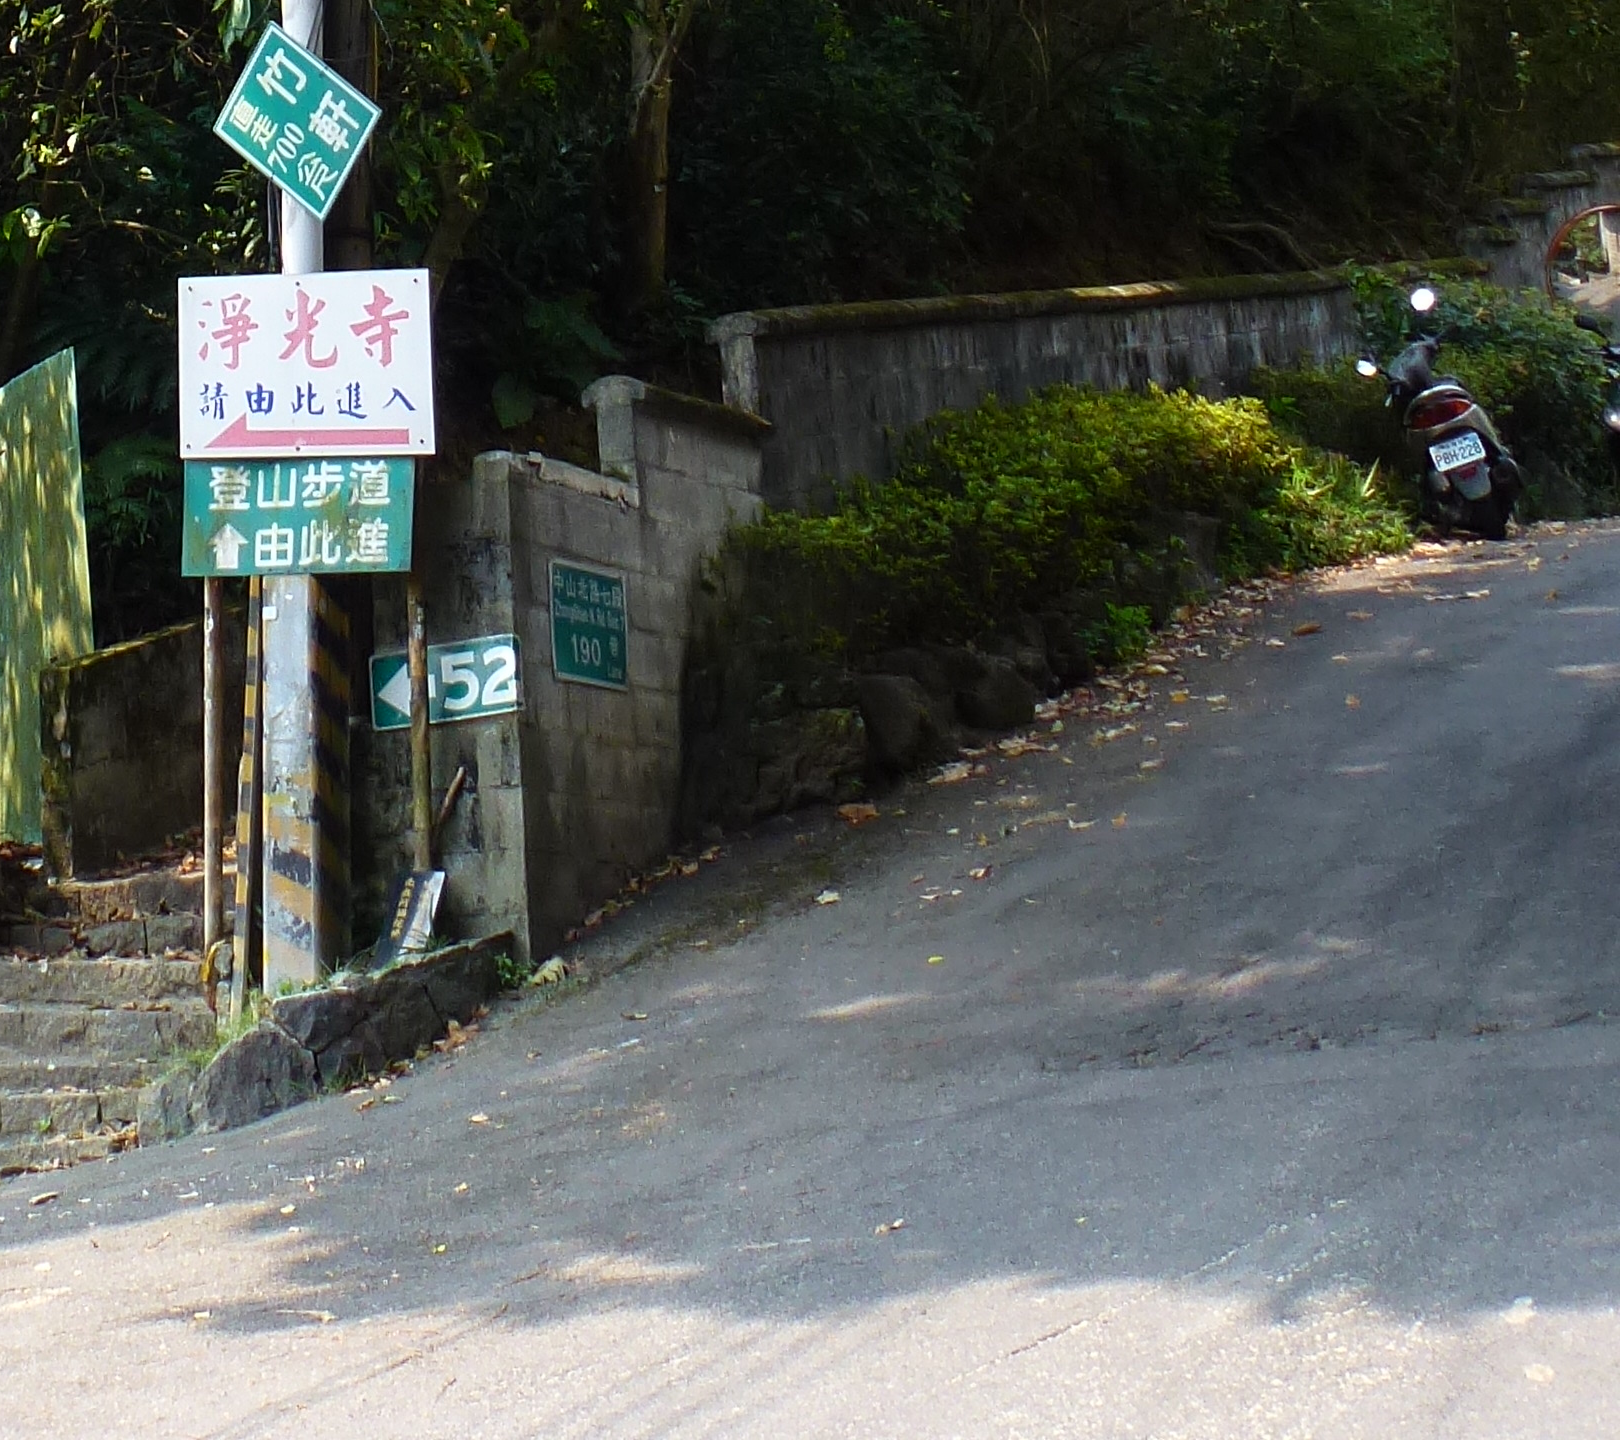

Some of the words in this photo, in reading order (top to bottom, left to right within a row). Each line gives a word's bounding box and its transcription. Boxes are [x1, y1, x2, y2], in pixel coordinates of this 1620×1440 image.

[256, 47, 360, 152] 竹軒
[198, 284, 410, 370] 淨光寺
[199, 380, 418, 420] 請由此進入
[208, 459, 391, 511] 登山步道
[254, 517, 390, 568] 由此進
[570, 632, 601, 667] 190
[440, 645, 518, 711] 52
